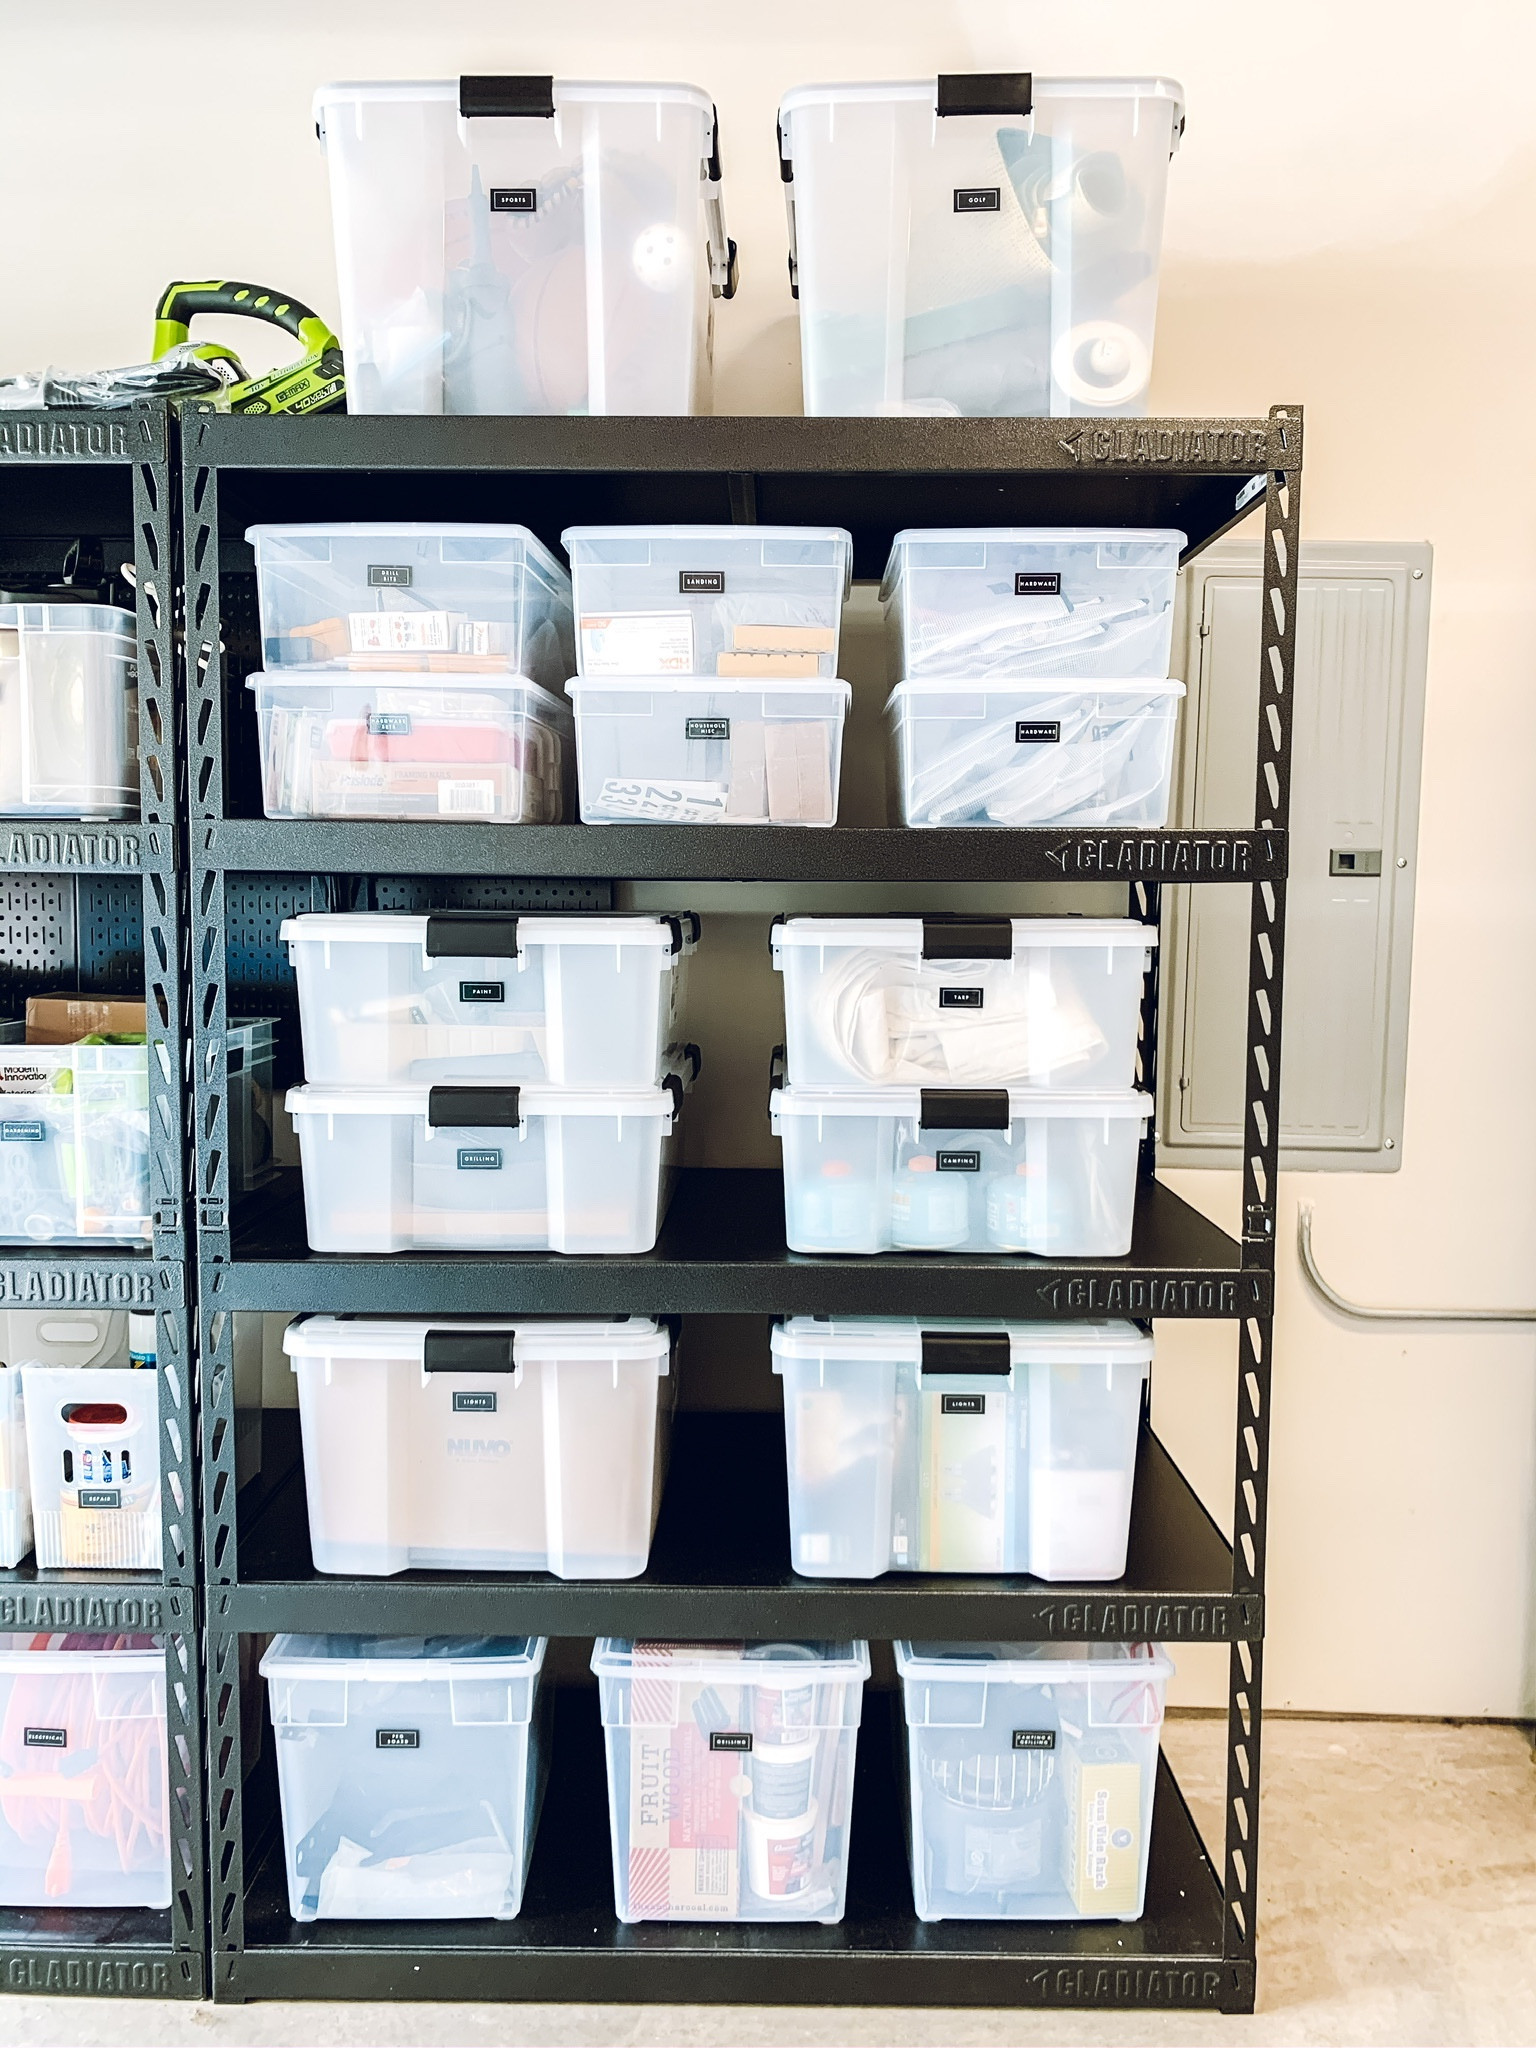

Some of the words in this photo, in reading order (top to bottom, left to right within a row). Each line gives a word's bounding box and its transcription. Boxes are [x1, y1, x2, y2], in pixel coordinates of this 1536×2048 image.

[1093, 429, 1267, 464] GLADIATOR
[0, 833, 141, 866] ADIATOR
[1077, 840, 1250, 872] GLADIATOR
[1068, 1279, 1237, 1311] GLADIATOR
[448, 1438, 511, 1456] NUVO
[1064, 1604, 1227, 1635] GLADIATOR
[641, 1744, 659, 1826] FRUIT
[662, 1747, 680, 1823] WOOD
[1097, 1791, 1107, 1821] Sous
[1096, 1825, 1107, 1852] Vide
[1096, 1857, 1106, 1888] Rack
[8, 1958, 172, 1993] GLADIATOR
[1056, 1968, 1222, 1999] GLADIATOR
